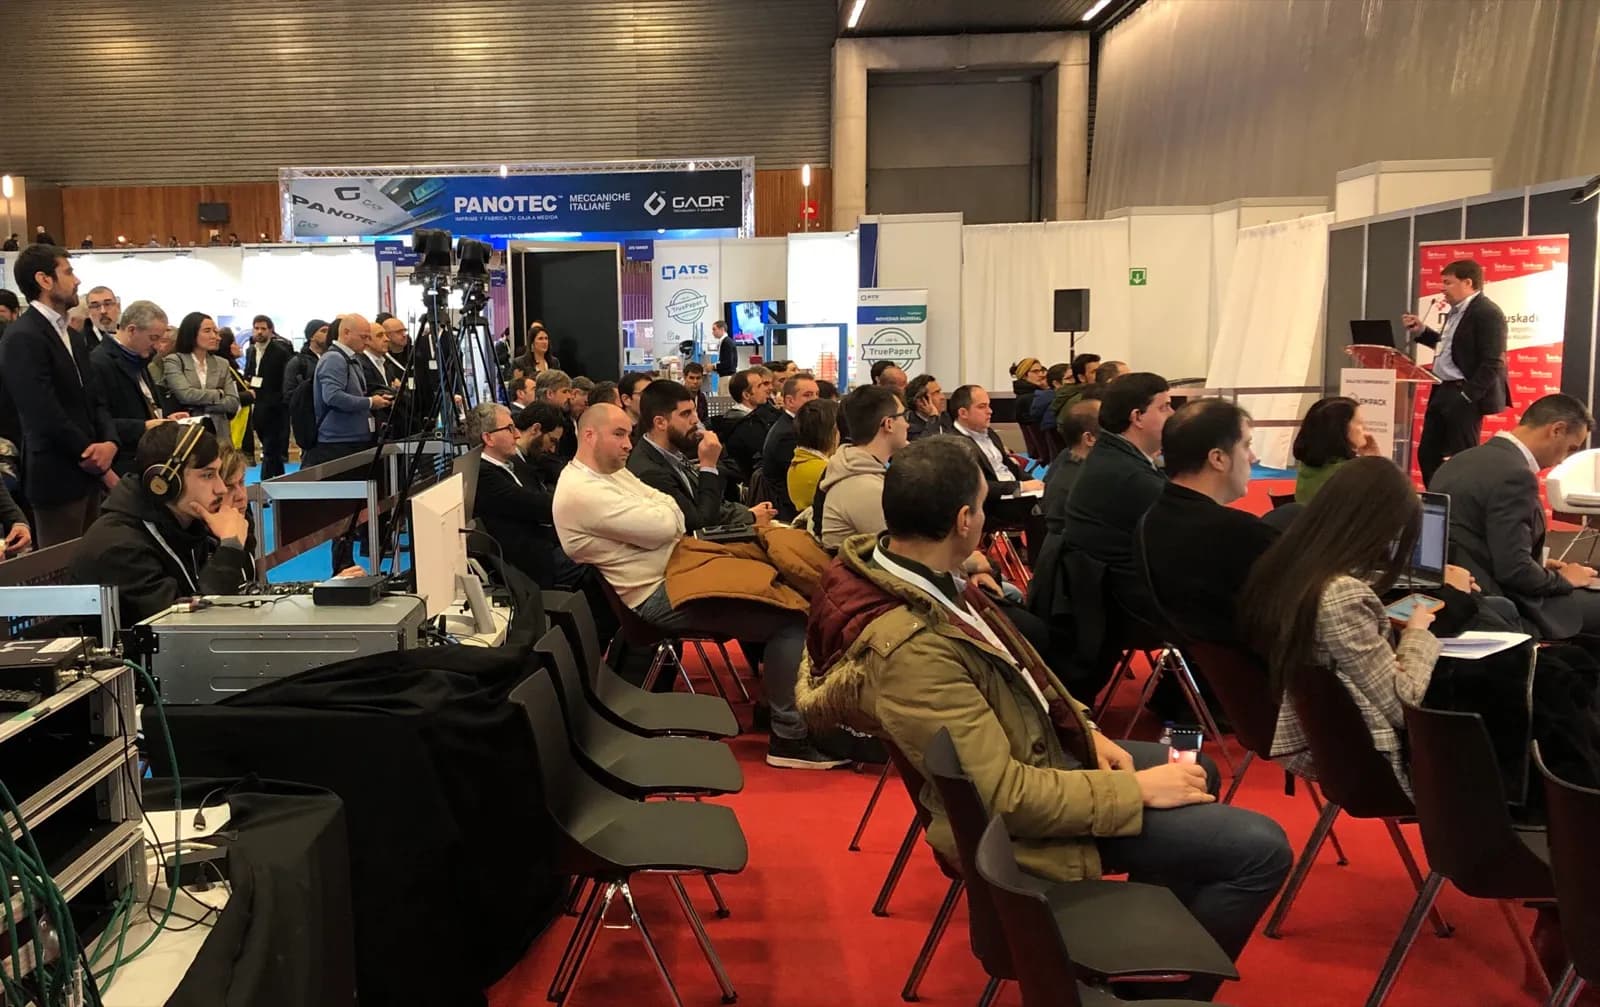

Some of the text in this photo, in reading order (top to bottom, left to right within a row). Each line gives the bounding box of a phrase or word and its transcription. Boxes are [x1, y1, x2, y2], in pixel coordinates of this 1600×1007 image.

[570, 193, 631, 203] MECCANICHE
[673, 196, 725, 208] GAOR
[292, 194, 377, 225] PANOTEC
[454, 196, 558, 213] PANOTEC
[570, 203, 611, 212] ITALIANE
[678, 265, 709, 275] ATS
[1503, 313, 1540, 323] uskad
[869, 347, 914, 357] TruePaper
